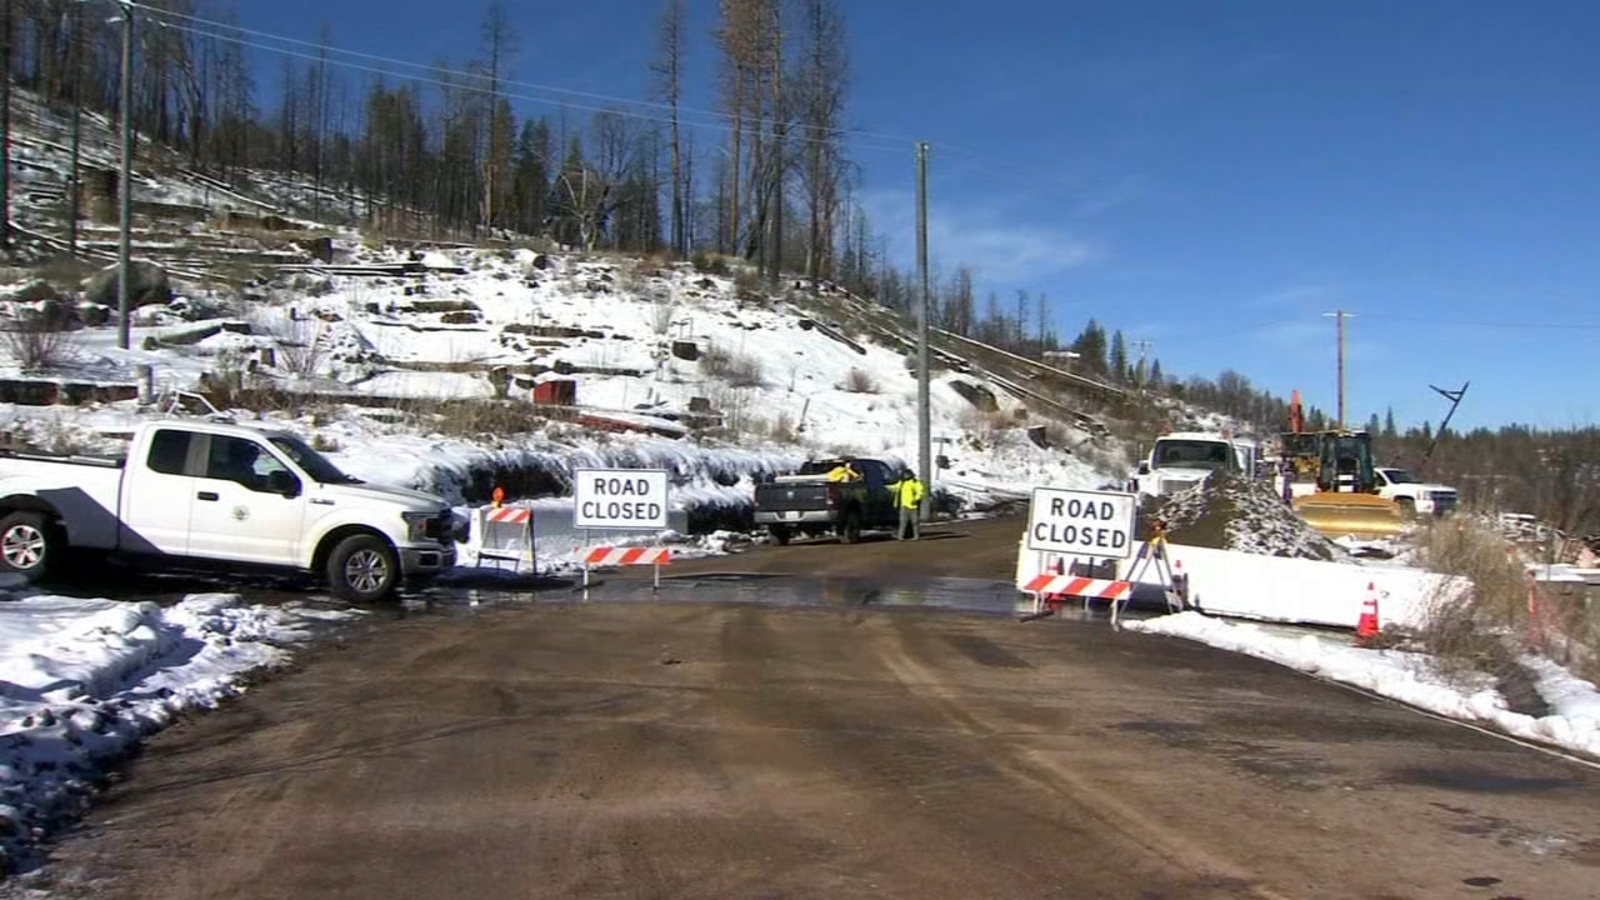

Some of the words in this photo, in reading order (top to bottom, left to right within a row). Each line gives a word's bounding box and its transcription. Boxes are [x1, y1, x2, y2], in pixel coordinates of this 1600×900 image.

[594, 478, 650, 496] ROAD
[582, 501, 661, 520] CLOSED
[1050, 498, 1115, 521] ROAD
[1034, 522, 1126, 548] CLOSED
